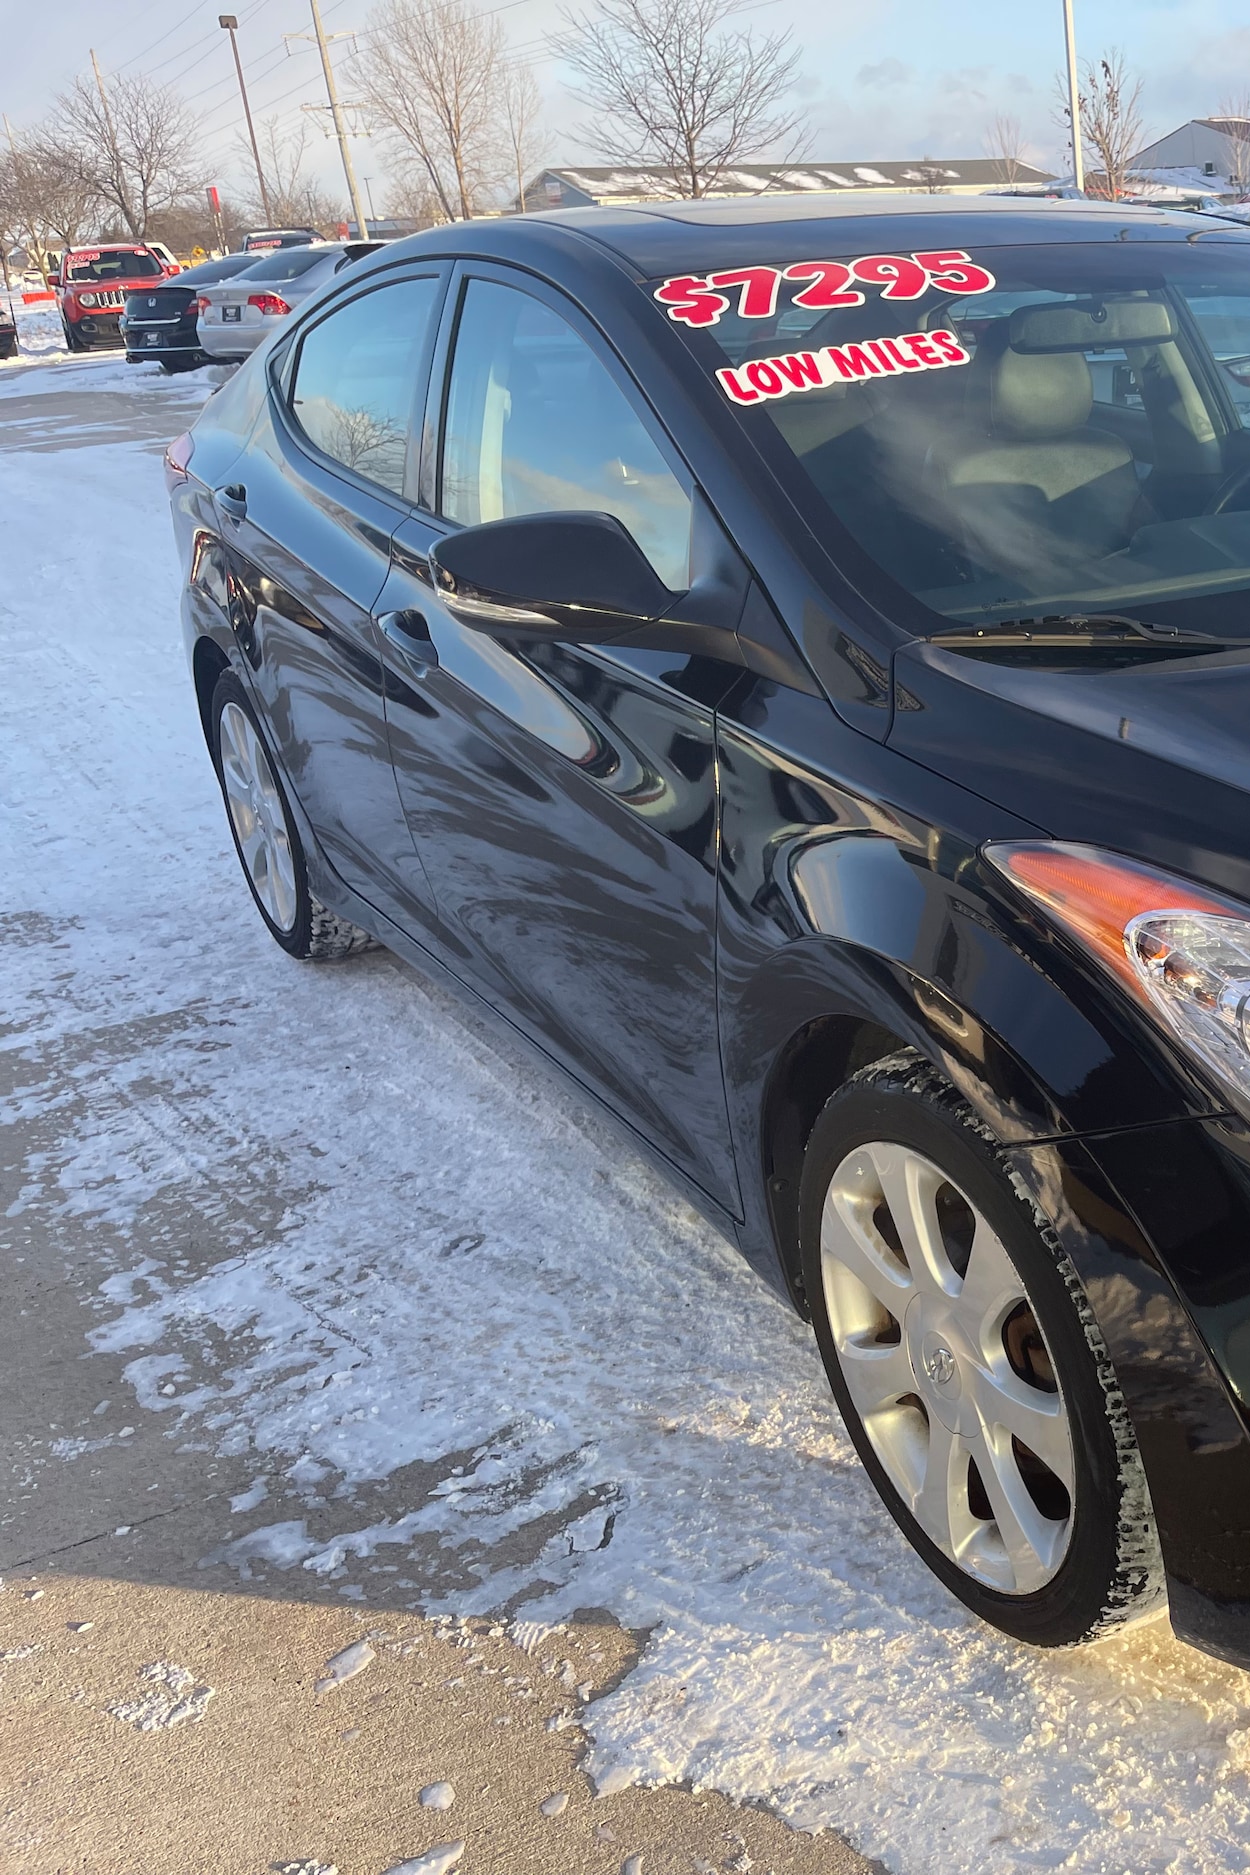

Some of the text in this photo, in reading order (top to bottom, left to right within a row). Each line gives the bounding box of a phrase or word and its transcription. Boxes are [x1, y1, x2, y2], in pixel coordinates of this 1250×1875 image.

[656, 251, 994, 327] $7295
[720, 330, 966, 402] LOW MILES
